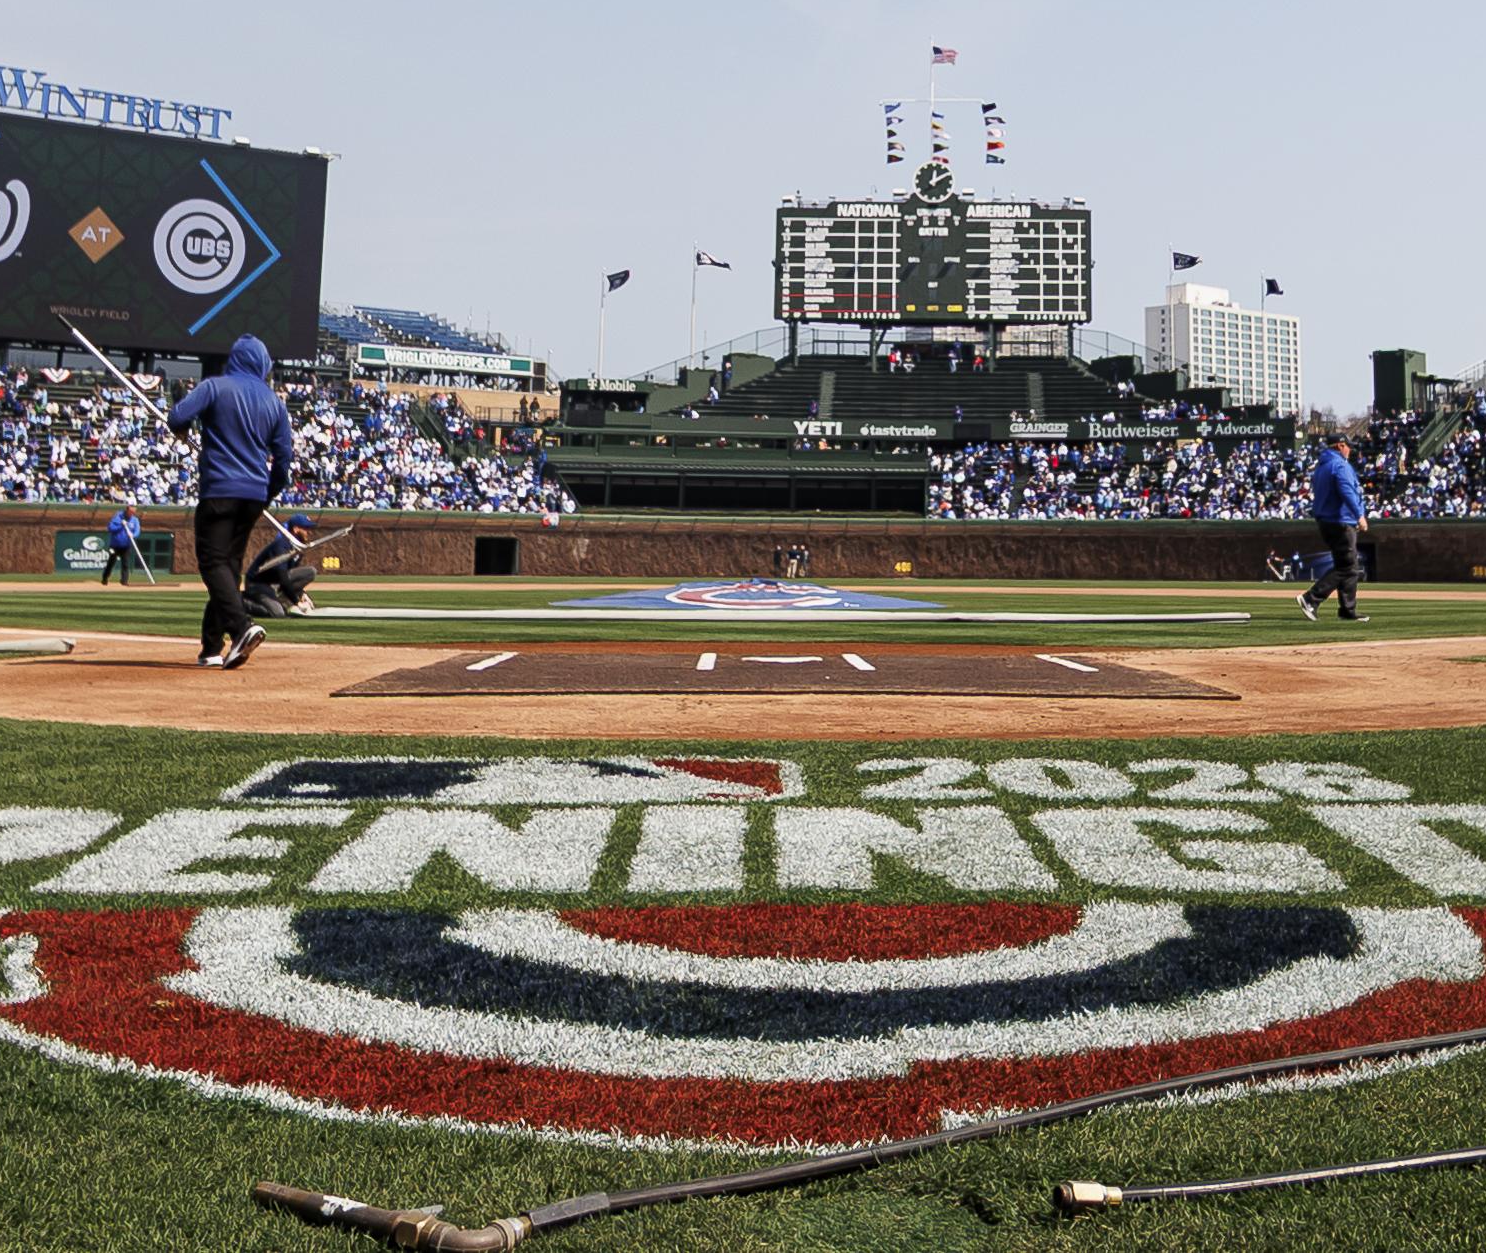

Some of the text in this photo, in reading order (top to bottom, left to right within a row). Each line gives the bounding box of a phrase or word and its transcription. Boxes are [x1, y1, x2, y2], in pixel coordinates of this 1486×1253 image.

[837, 204, 902, 217] NATIONAL
[966, 204, 1031, 218] AMERICAN
[81, 225, 112, 244] AT
[50, 304, 130, 322] WRIGLEY FIELD
[384, 348, 511, 371] WRIGLEYROOFTOPS.COM
[793, 420, 843, 436] YETI
[869, 423, 937, 437] tastytrade
[1009, 422, 1069, 434] GRAINGER
[1214, 424, 1274, 436] Advocate
[63, 548, 110, 562] Gallagh
